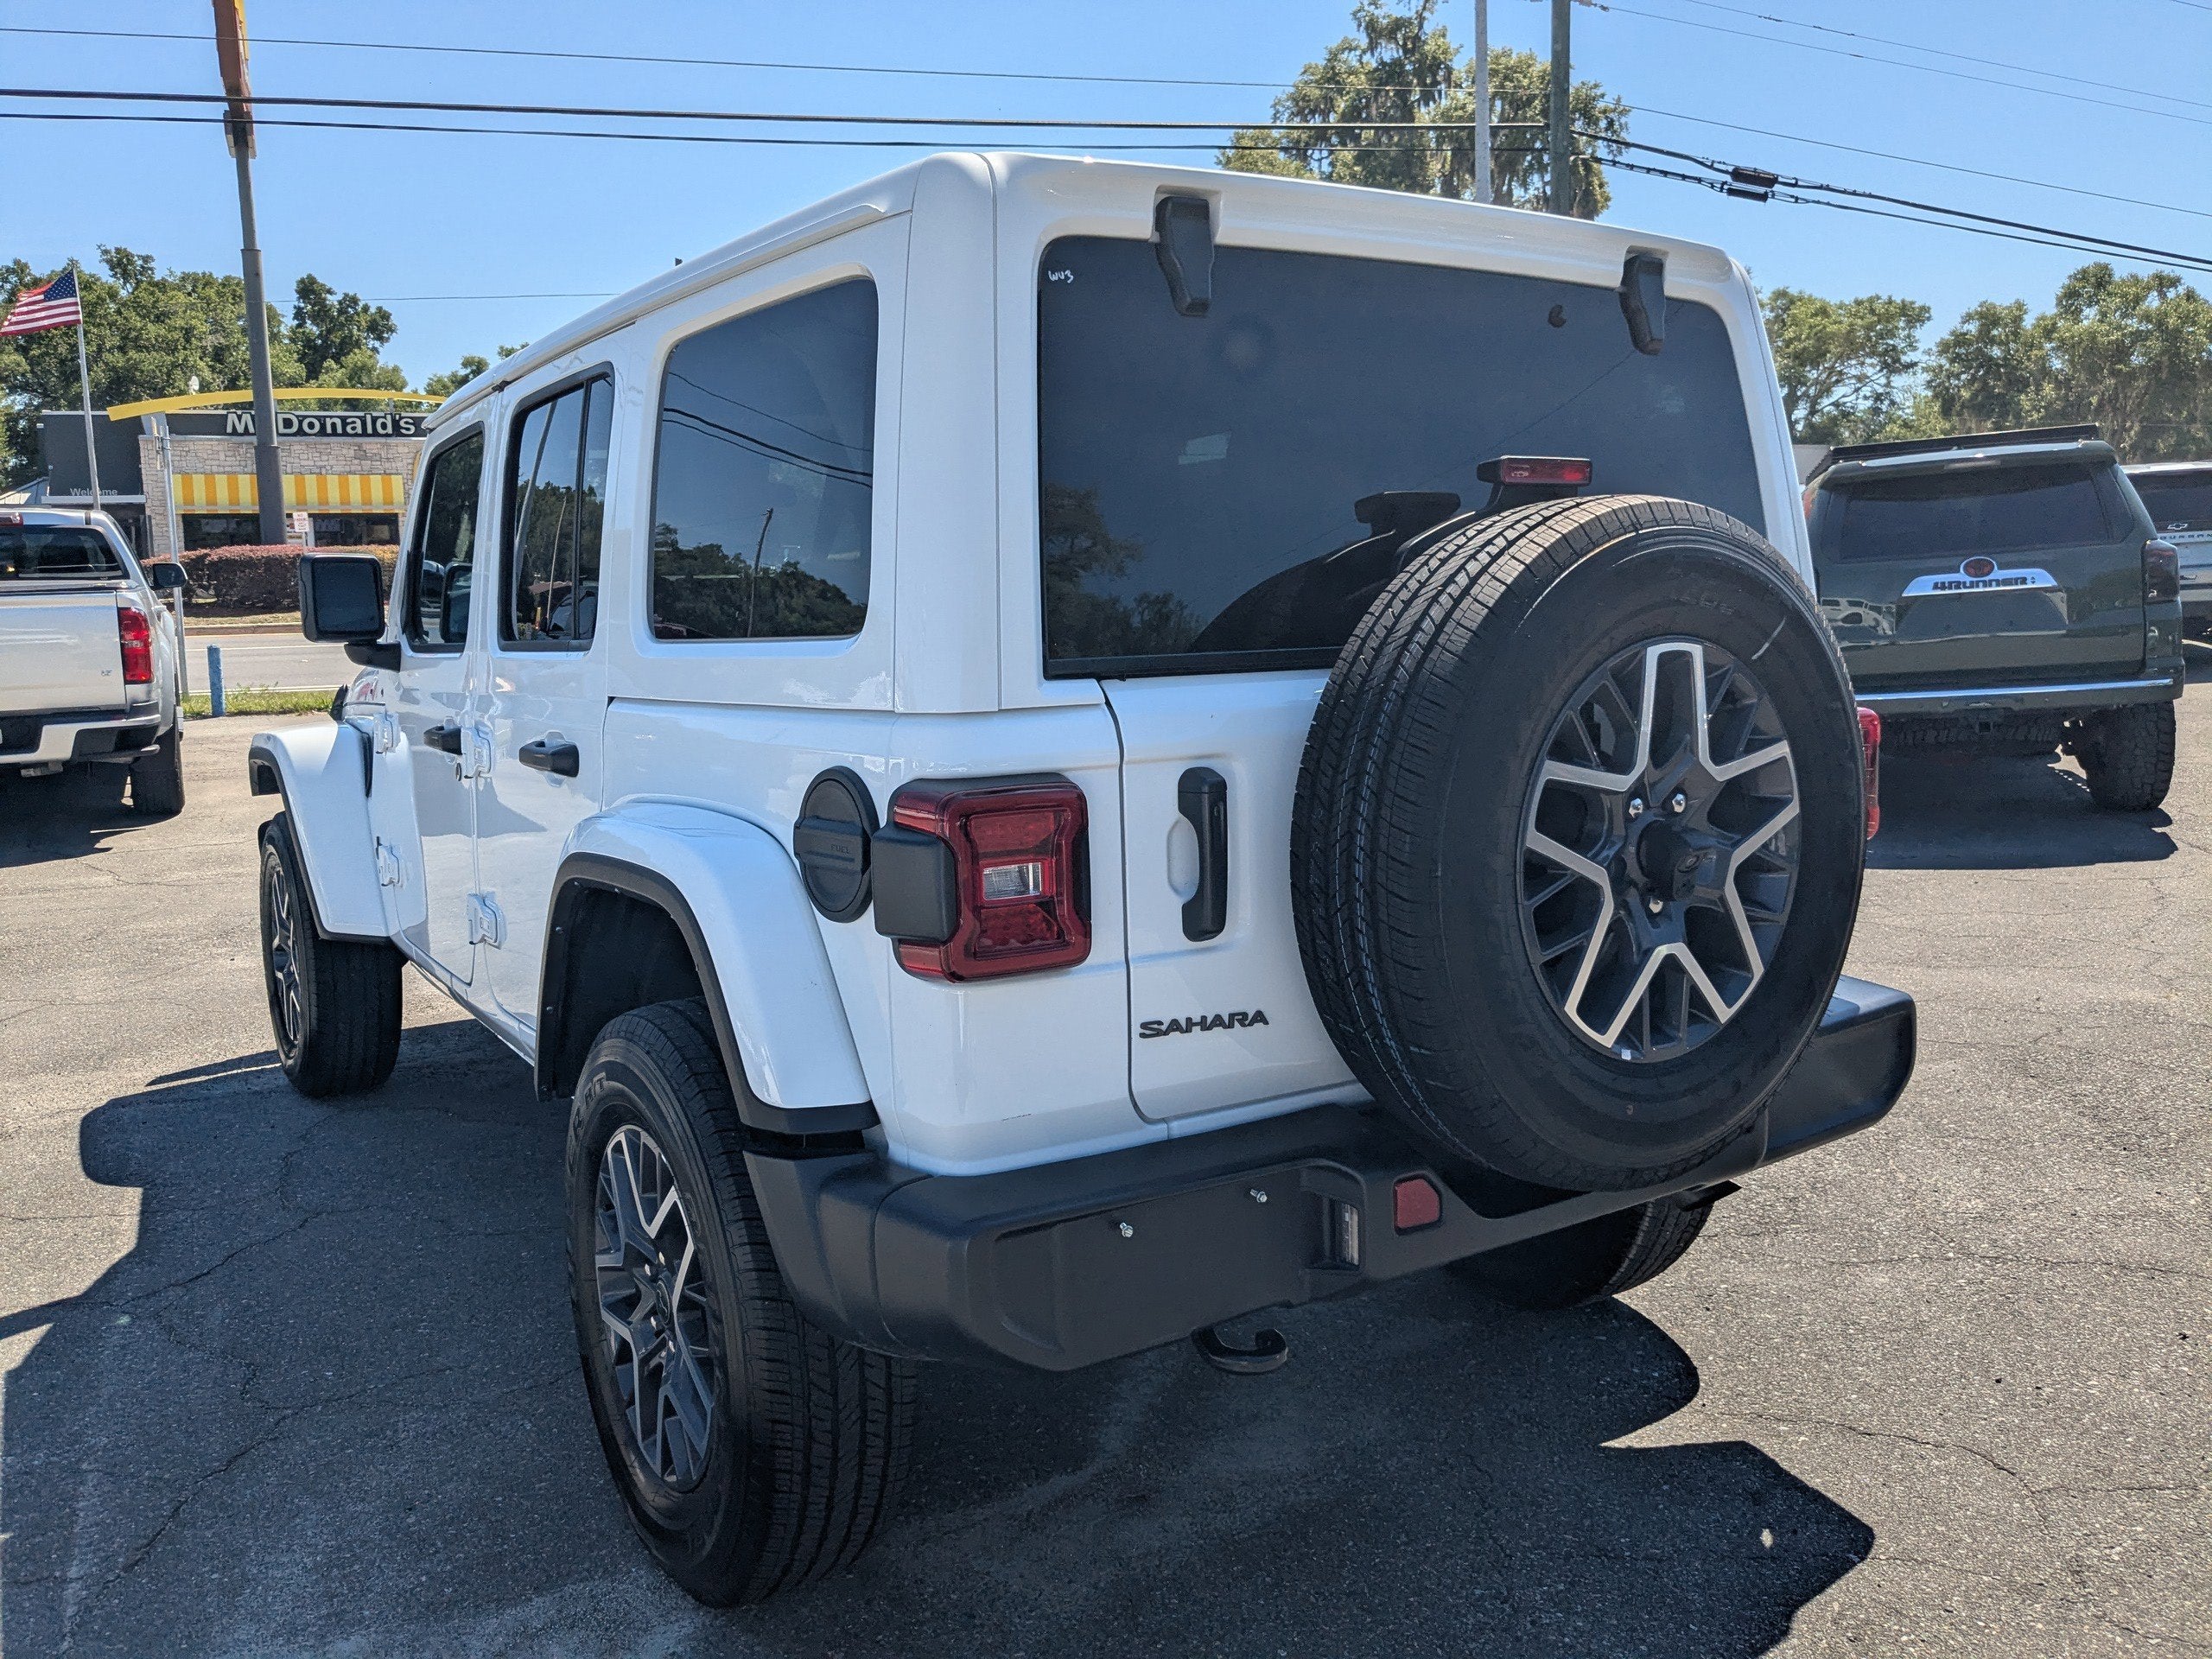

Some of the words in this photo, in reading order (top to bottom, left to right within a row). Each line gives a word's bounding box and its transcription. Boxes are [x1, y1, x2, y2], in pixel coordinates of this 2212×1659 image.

[226, 412, 416, 435] MDonald's
[830, 843, 850, 855] FUEL
[1139, 1009, 1270, 1039] SAHARA
